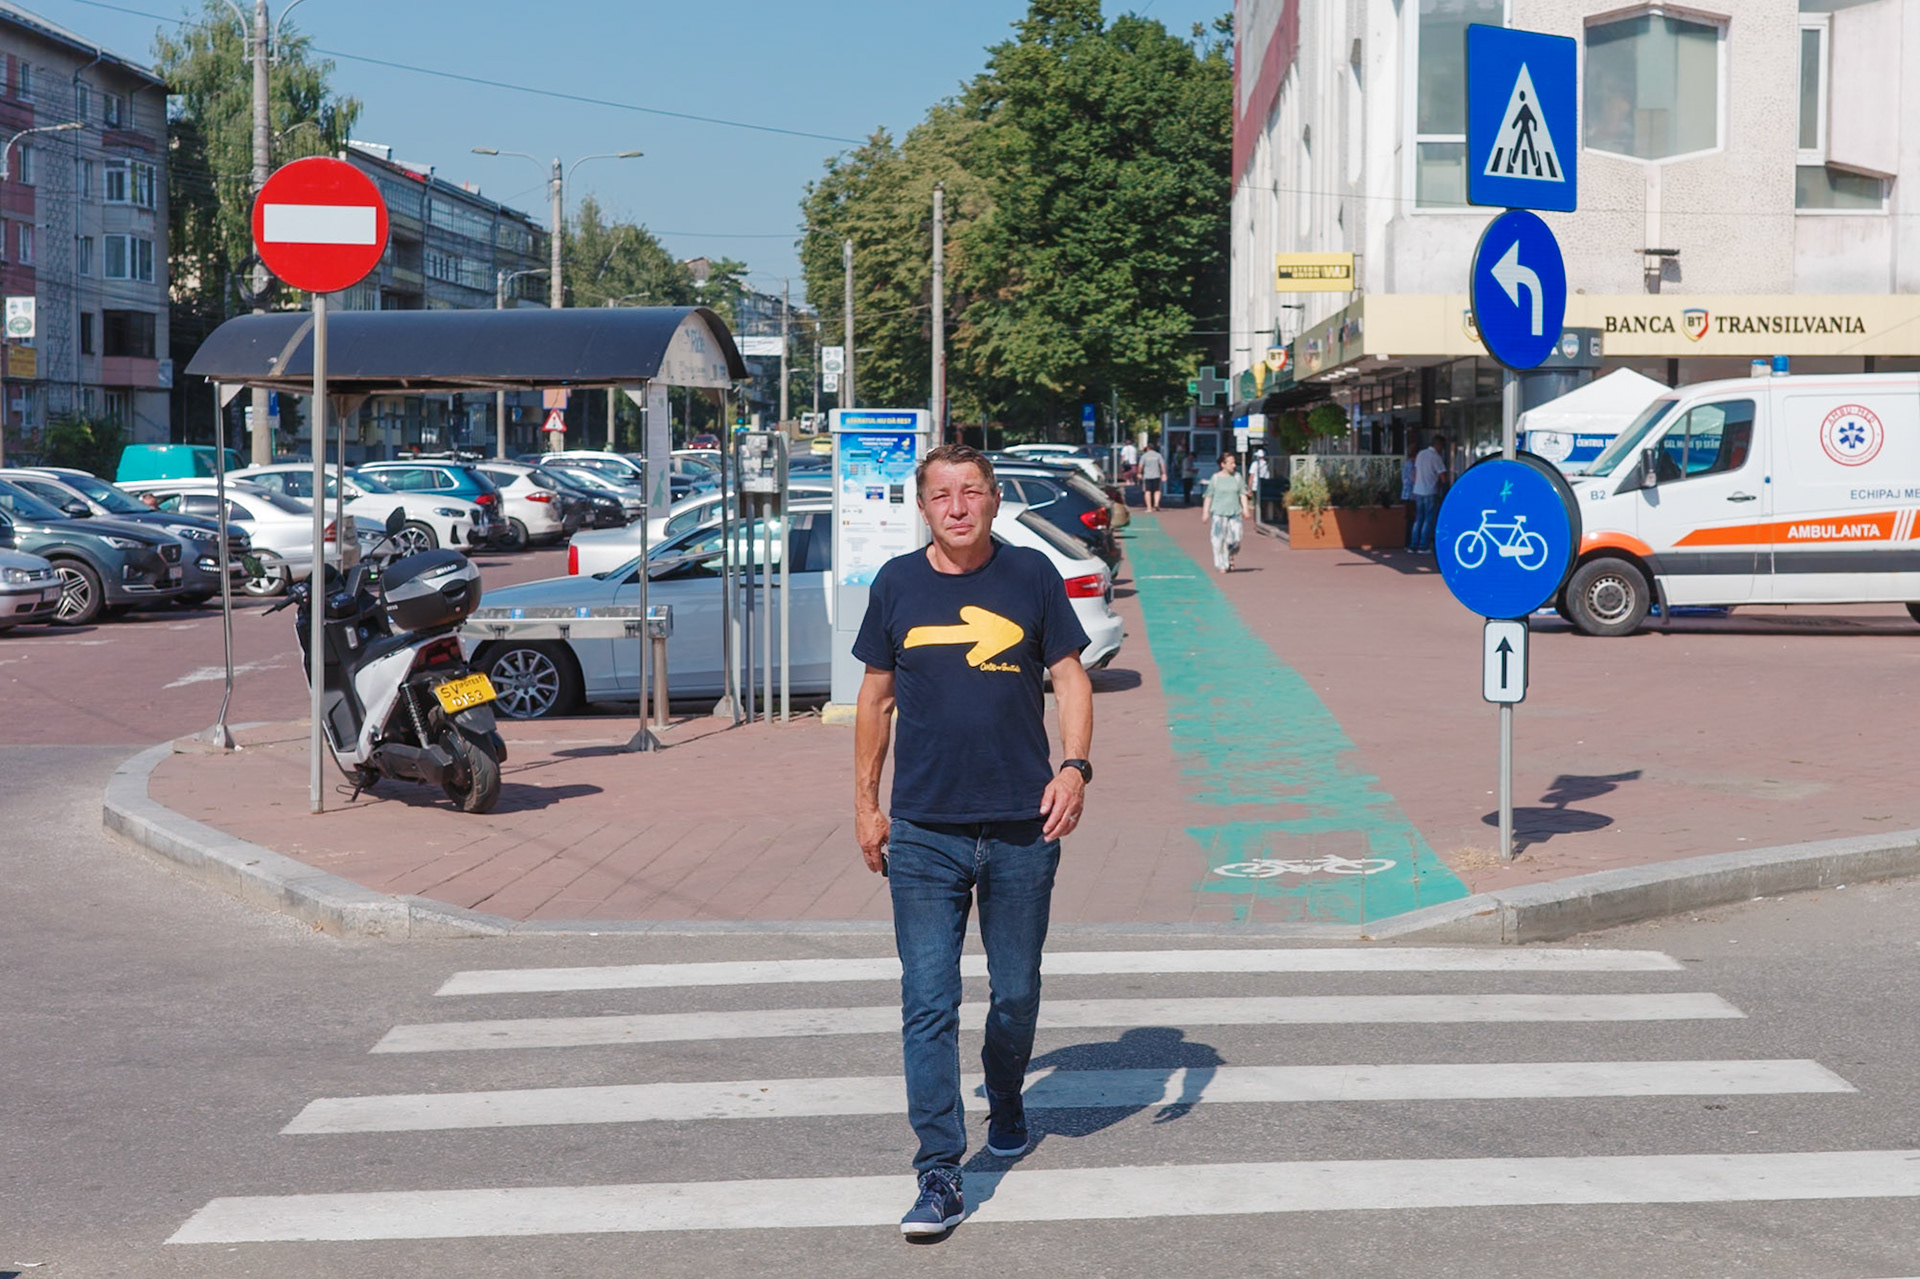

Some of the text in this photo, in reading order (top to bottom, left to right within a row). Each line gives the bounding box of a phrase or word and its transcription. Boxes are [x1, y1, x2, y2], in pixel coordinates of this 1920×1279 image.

[1323, 266, 1348, 278] WU
[1605, 316, 1866, 334] BANCA BT TRANSILVANIA
[1269, 352, 1282, 360] BT
[1590, 490, 1606, 500] B2
[1850, 489, 1920, 500] ECHIPAJ ME
[1787, 524, 1881, 539] AMBULANTA
[440, 684, 459, 699] SV
